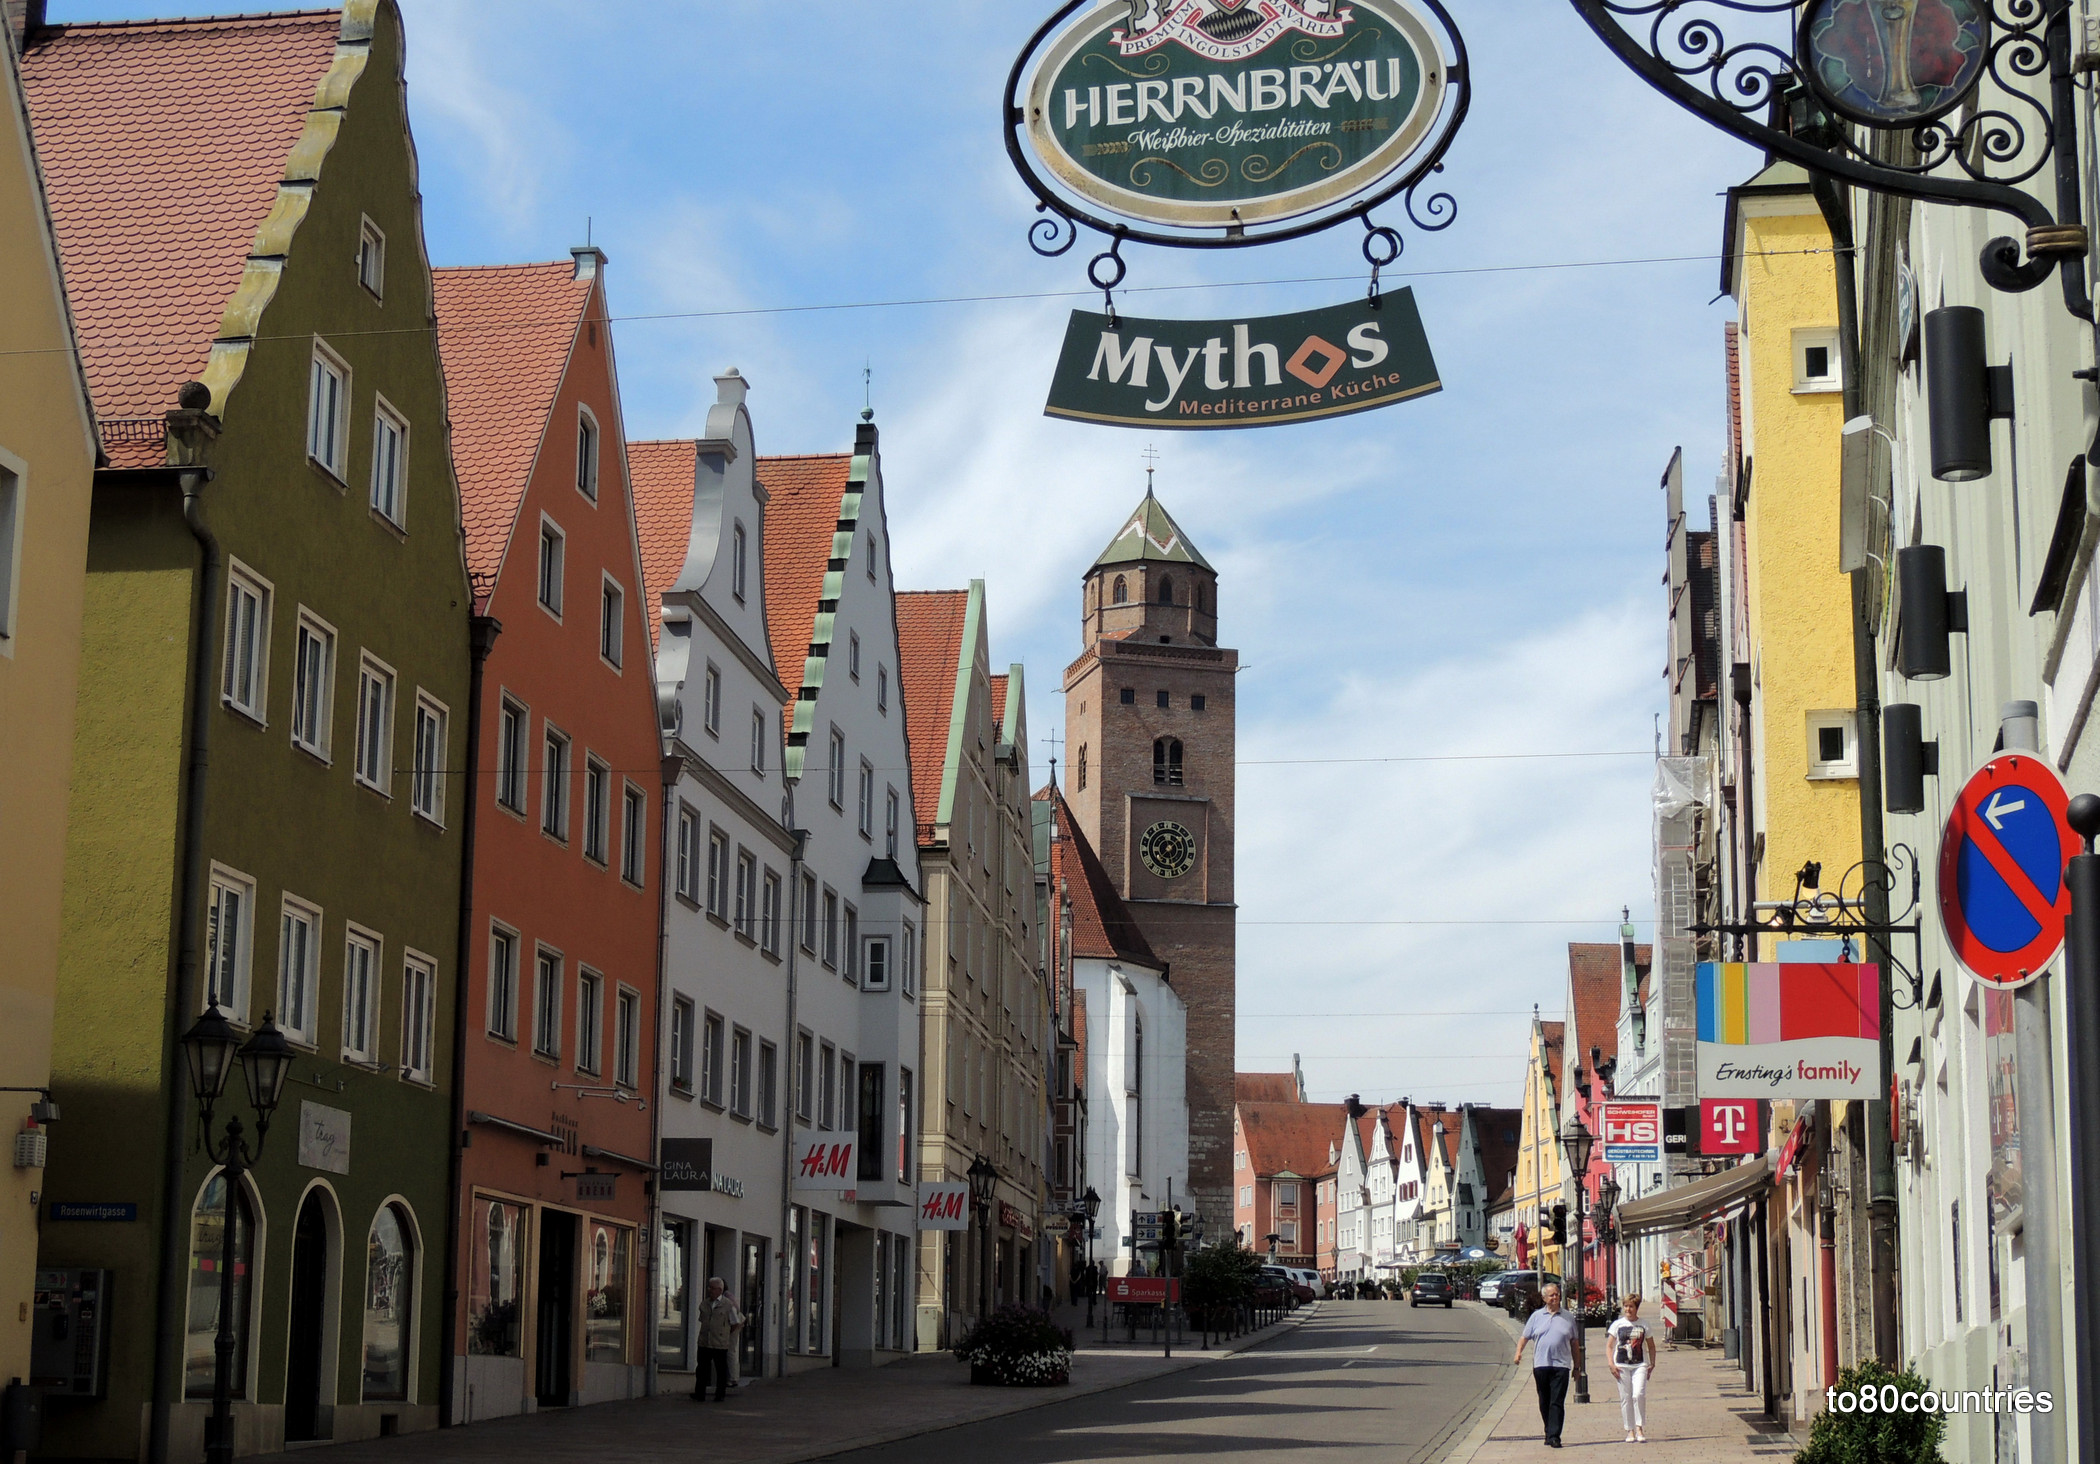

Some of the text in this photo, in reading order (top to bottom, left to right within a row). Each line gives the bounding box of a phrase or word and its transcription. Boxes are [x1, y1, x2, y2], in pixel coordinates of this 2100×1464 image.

[1124, 3, 1195, 54] PREMIUM
[1176, 18, 1285, 58] INGOLSTADT
[1064, 57, 1401, 130] HERRNBRÄU
[1127, 117, 1331, 152] Weißbier-Spezialitäten
[1178, 371, 1401, 416] Mediterrane Küche
[1715, 1059, 1862, 1087] Ernsting's family
[1606, 1122, 1656, 1142] HS
[1665, 1134, 1687, 1144] GER
[663, 1160, 693, 1171] GINA
[800, 1143, 852, 1178] H&M
[663, 1170, 709, 1181] LAURA
[714, 1172, 745, 1199] NA LAURA
[60, 1204, 127, 1219] Rosenwirtgasse
[921, 1191, 965, 1221] H&M
